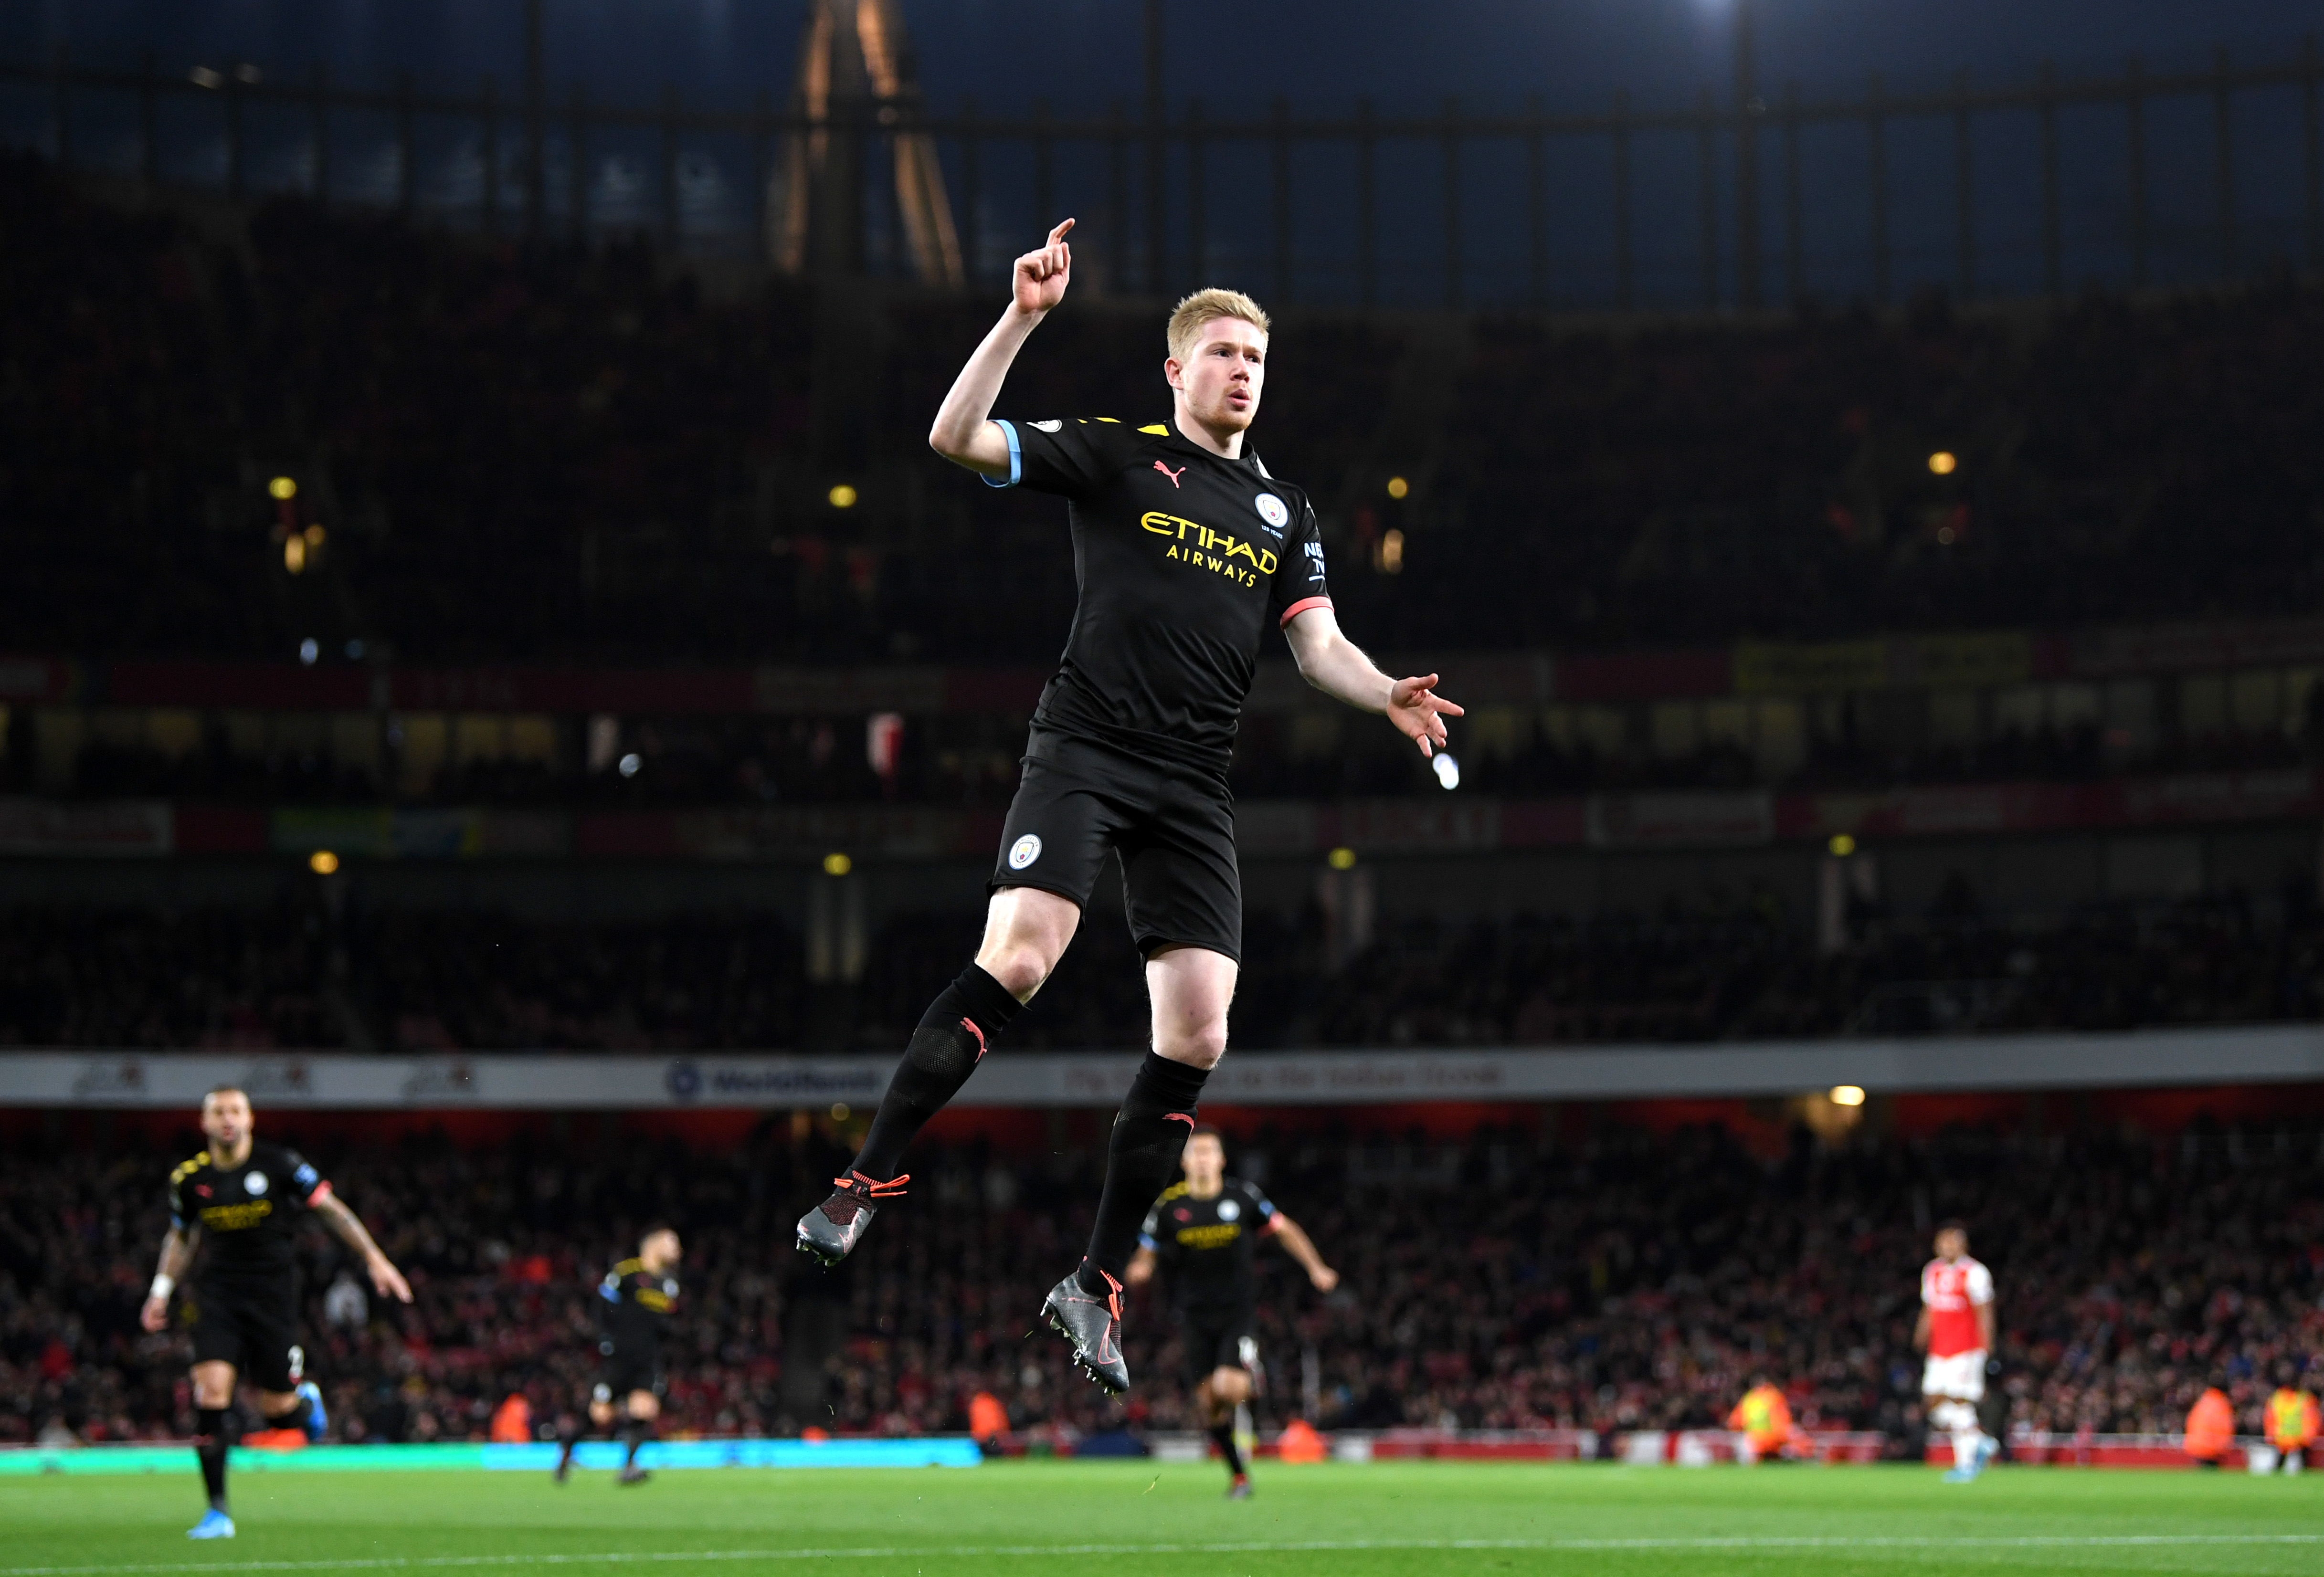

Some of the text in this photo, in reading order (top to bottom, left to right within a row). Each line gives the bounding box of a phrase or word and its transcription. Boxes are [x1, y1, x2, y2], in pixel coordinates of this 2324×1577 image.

[1141, 511, 1278, 575] ETIHAD
[1270, 528, 1283, 539] YEARS
[1166, 544, 1256, 588] AIRWAYS
